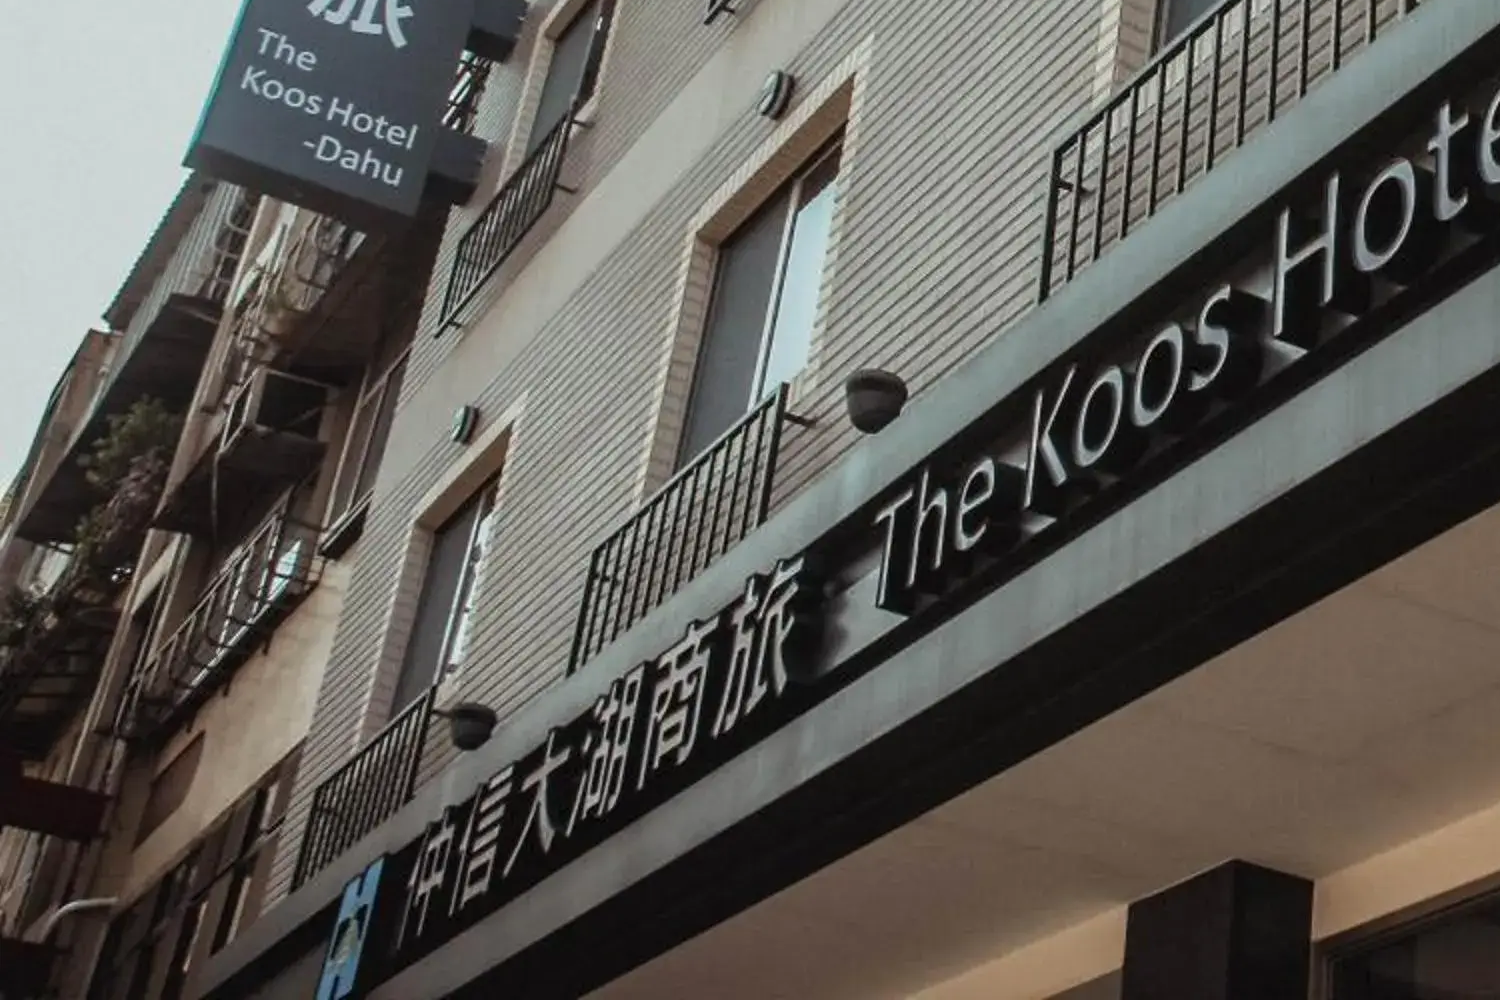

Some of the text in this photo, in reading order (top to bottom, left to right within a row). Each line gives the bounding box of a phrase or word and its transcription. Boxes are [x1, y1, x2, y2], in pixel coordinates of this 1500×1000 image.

[256, 27, 318, 74] The
[240, 64, 419, 151] Koos Hotel
[302, 135, 404, 189] -Dahu
[873, 455, 996, 608] The
[1023, 283, 1233, 510] Koos
[396, 556, 805, 951] 仲信大湖商旅
